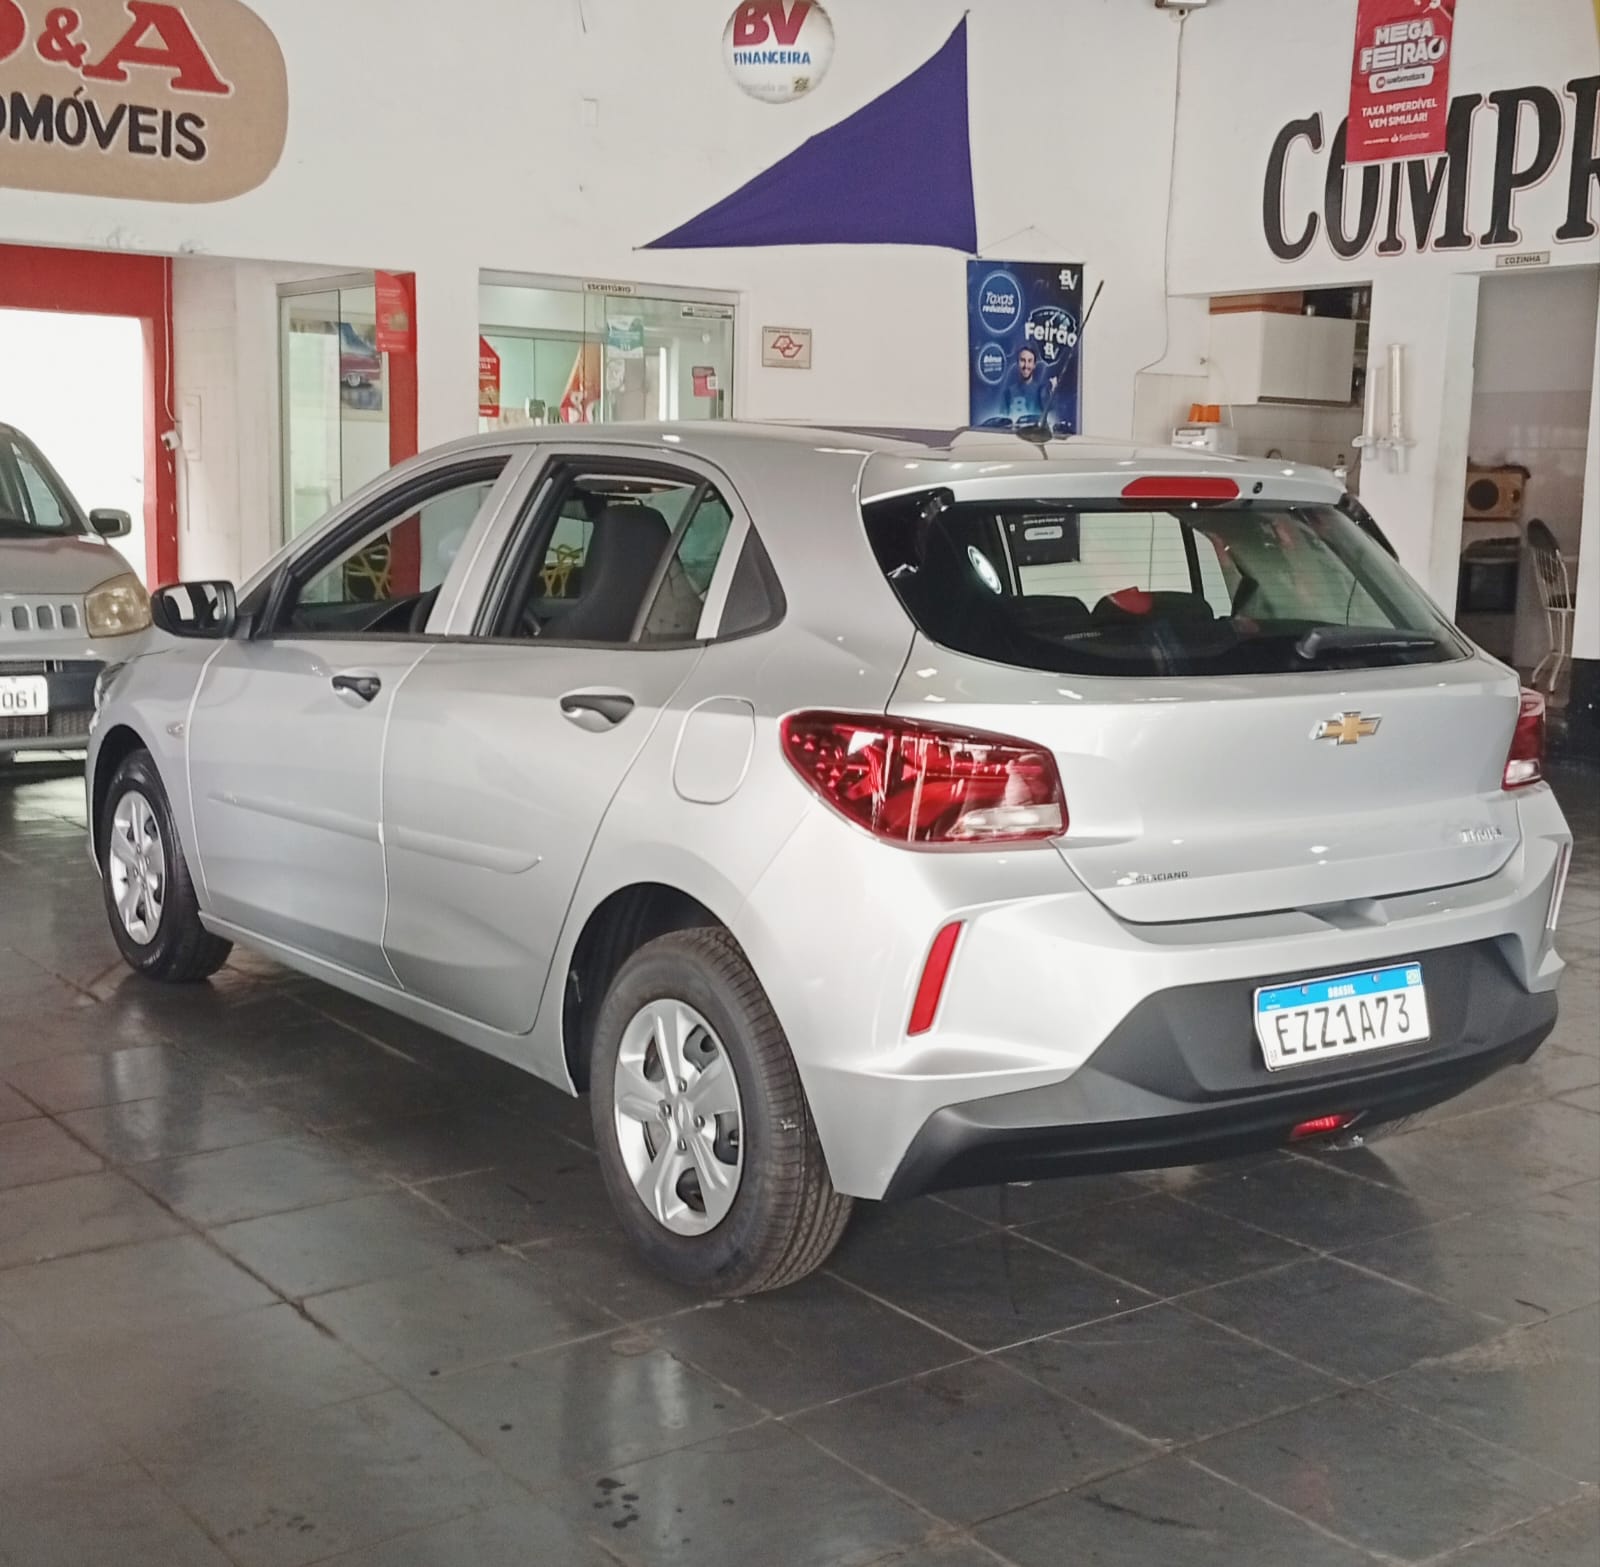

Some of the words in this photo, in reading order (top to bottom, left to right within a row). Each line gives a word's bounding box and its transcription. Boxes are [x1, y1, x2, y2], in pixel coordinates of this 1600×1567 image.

[733, 0, 812, 46] BV
[1375, 19, 1434, 45] MEGA
[733, 51, 812, 65] FINANCEIRA
[1361, 37, 1446, 71] FEIRÃO
[1362, 105, 1385, 117] TAXA
[1386, 98, 1438, 113] IMPERDÍVEL
[0, 86, 207, 161] MÓVEIS
[1369, 116, 1388, 128] VEM
[1388, 112, 1428, 126] SIMULAR!
[1504, 255, 1541, 265] COZINHA
[587, 282, 632, 293] ESCRITÓRIO
[985, 291, 1014, 305] Taxas
[1025, 320, 1077, 347] Feirão
[1327, 983, 1356, 999] BRASIL
[1275, 993, 1411, 1056] EZZ1A73
